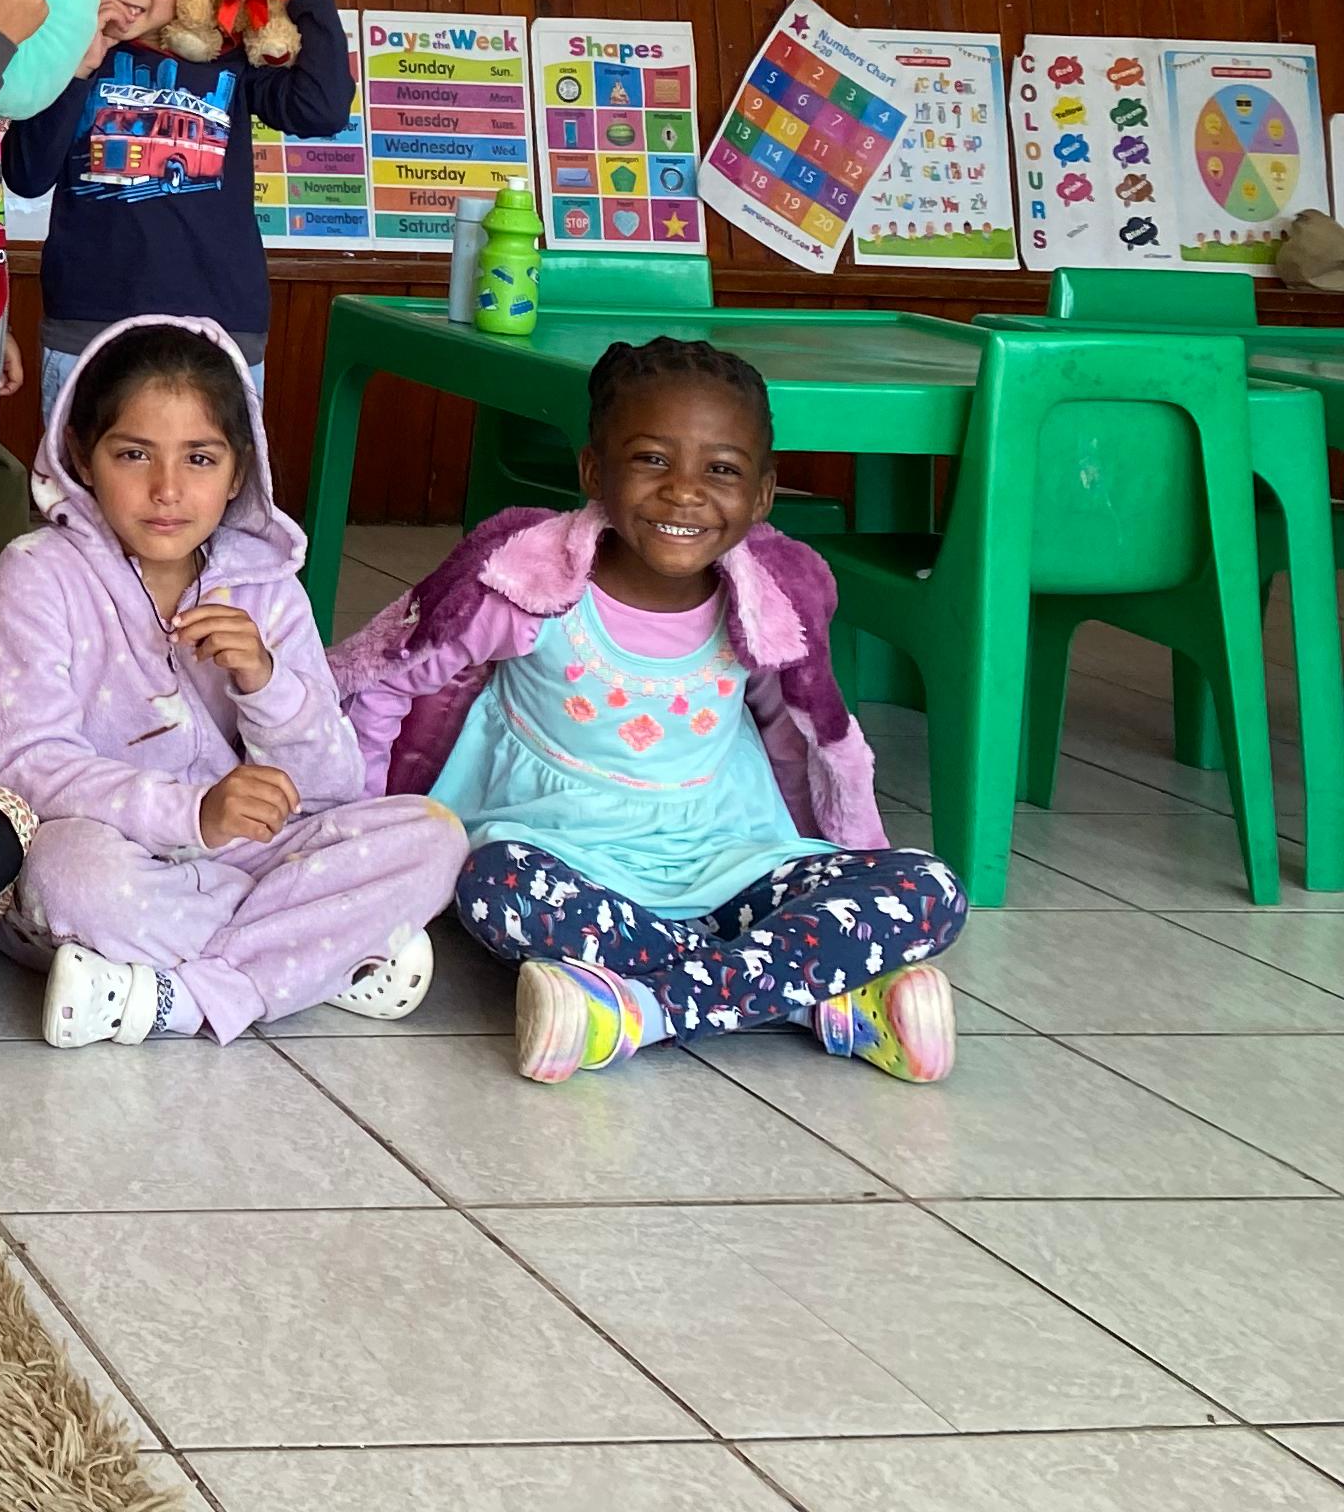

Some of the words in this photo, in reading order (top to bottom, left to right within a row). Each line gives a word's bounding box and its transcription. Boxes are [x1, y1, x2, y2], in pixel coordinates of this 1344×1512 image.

[370, 25, 430, 54] Days
[434, 30, 447, 39] of
[449, 29, 518, 52] Week
[432, 40, 450, 49] the
[569, 36, 664, 63] Shapes
[818, 29, 865, 67] Numbers
[866, 62, 897, 87] Chart
[398, 59, 455, 78] Sunday
[490, 67, 513, 76] Sun.
[813, 66, 825, 80] 2
[767, 71, 779, 84] 5
[396, 87, 458, 104] Monday
[798, 94, 810, 106] 6
[846, 88, 856, 101] 3
[751, 98, 763, 110] 9
[397, 112, 459, 131] Tuesday
[780, 118, 797, 134] 10
[831, 114, 843, 126] 7
[878, 111, 890, 124] 4
[736, 122, 751, 140] 13
[385, 138, 473, 158] Wednesday
[813, 139, 829, 156] 11
[863, 136, 875, 149] 8
[306, 149, 356, 163] October
[722, 148, 737, 165] 17
[766, 144, 784, 163] 14
[396, 165, 465, 184] Thursday
[798, 166, 816, 183] 15
[844, 160, 863, 179] 12
[304, 181, 362, 194] November
[751, 171, 768, 188] 18
[410, 192, 456, 209] Friday
[783, 193, 801, 209] 19
[831, 187, 847, 205] 16
[306, 211, 364, 225] December
[566, 217, 589, 229] STOP
[814, 214, 834, 232] 20
